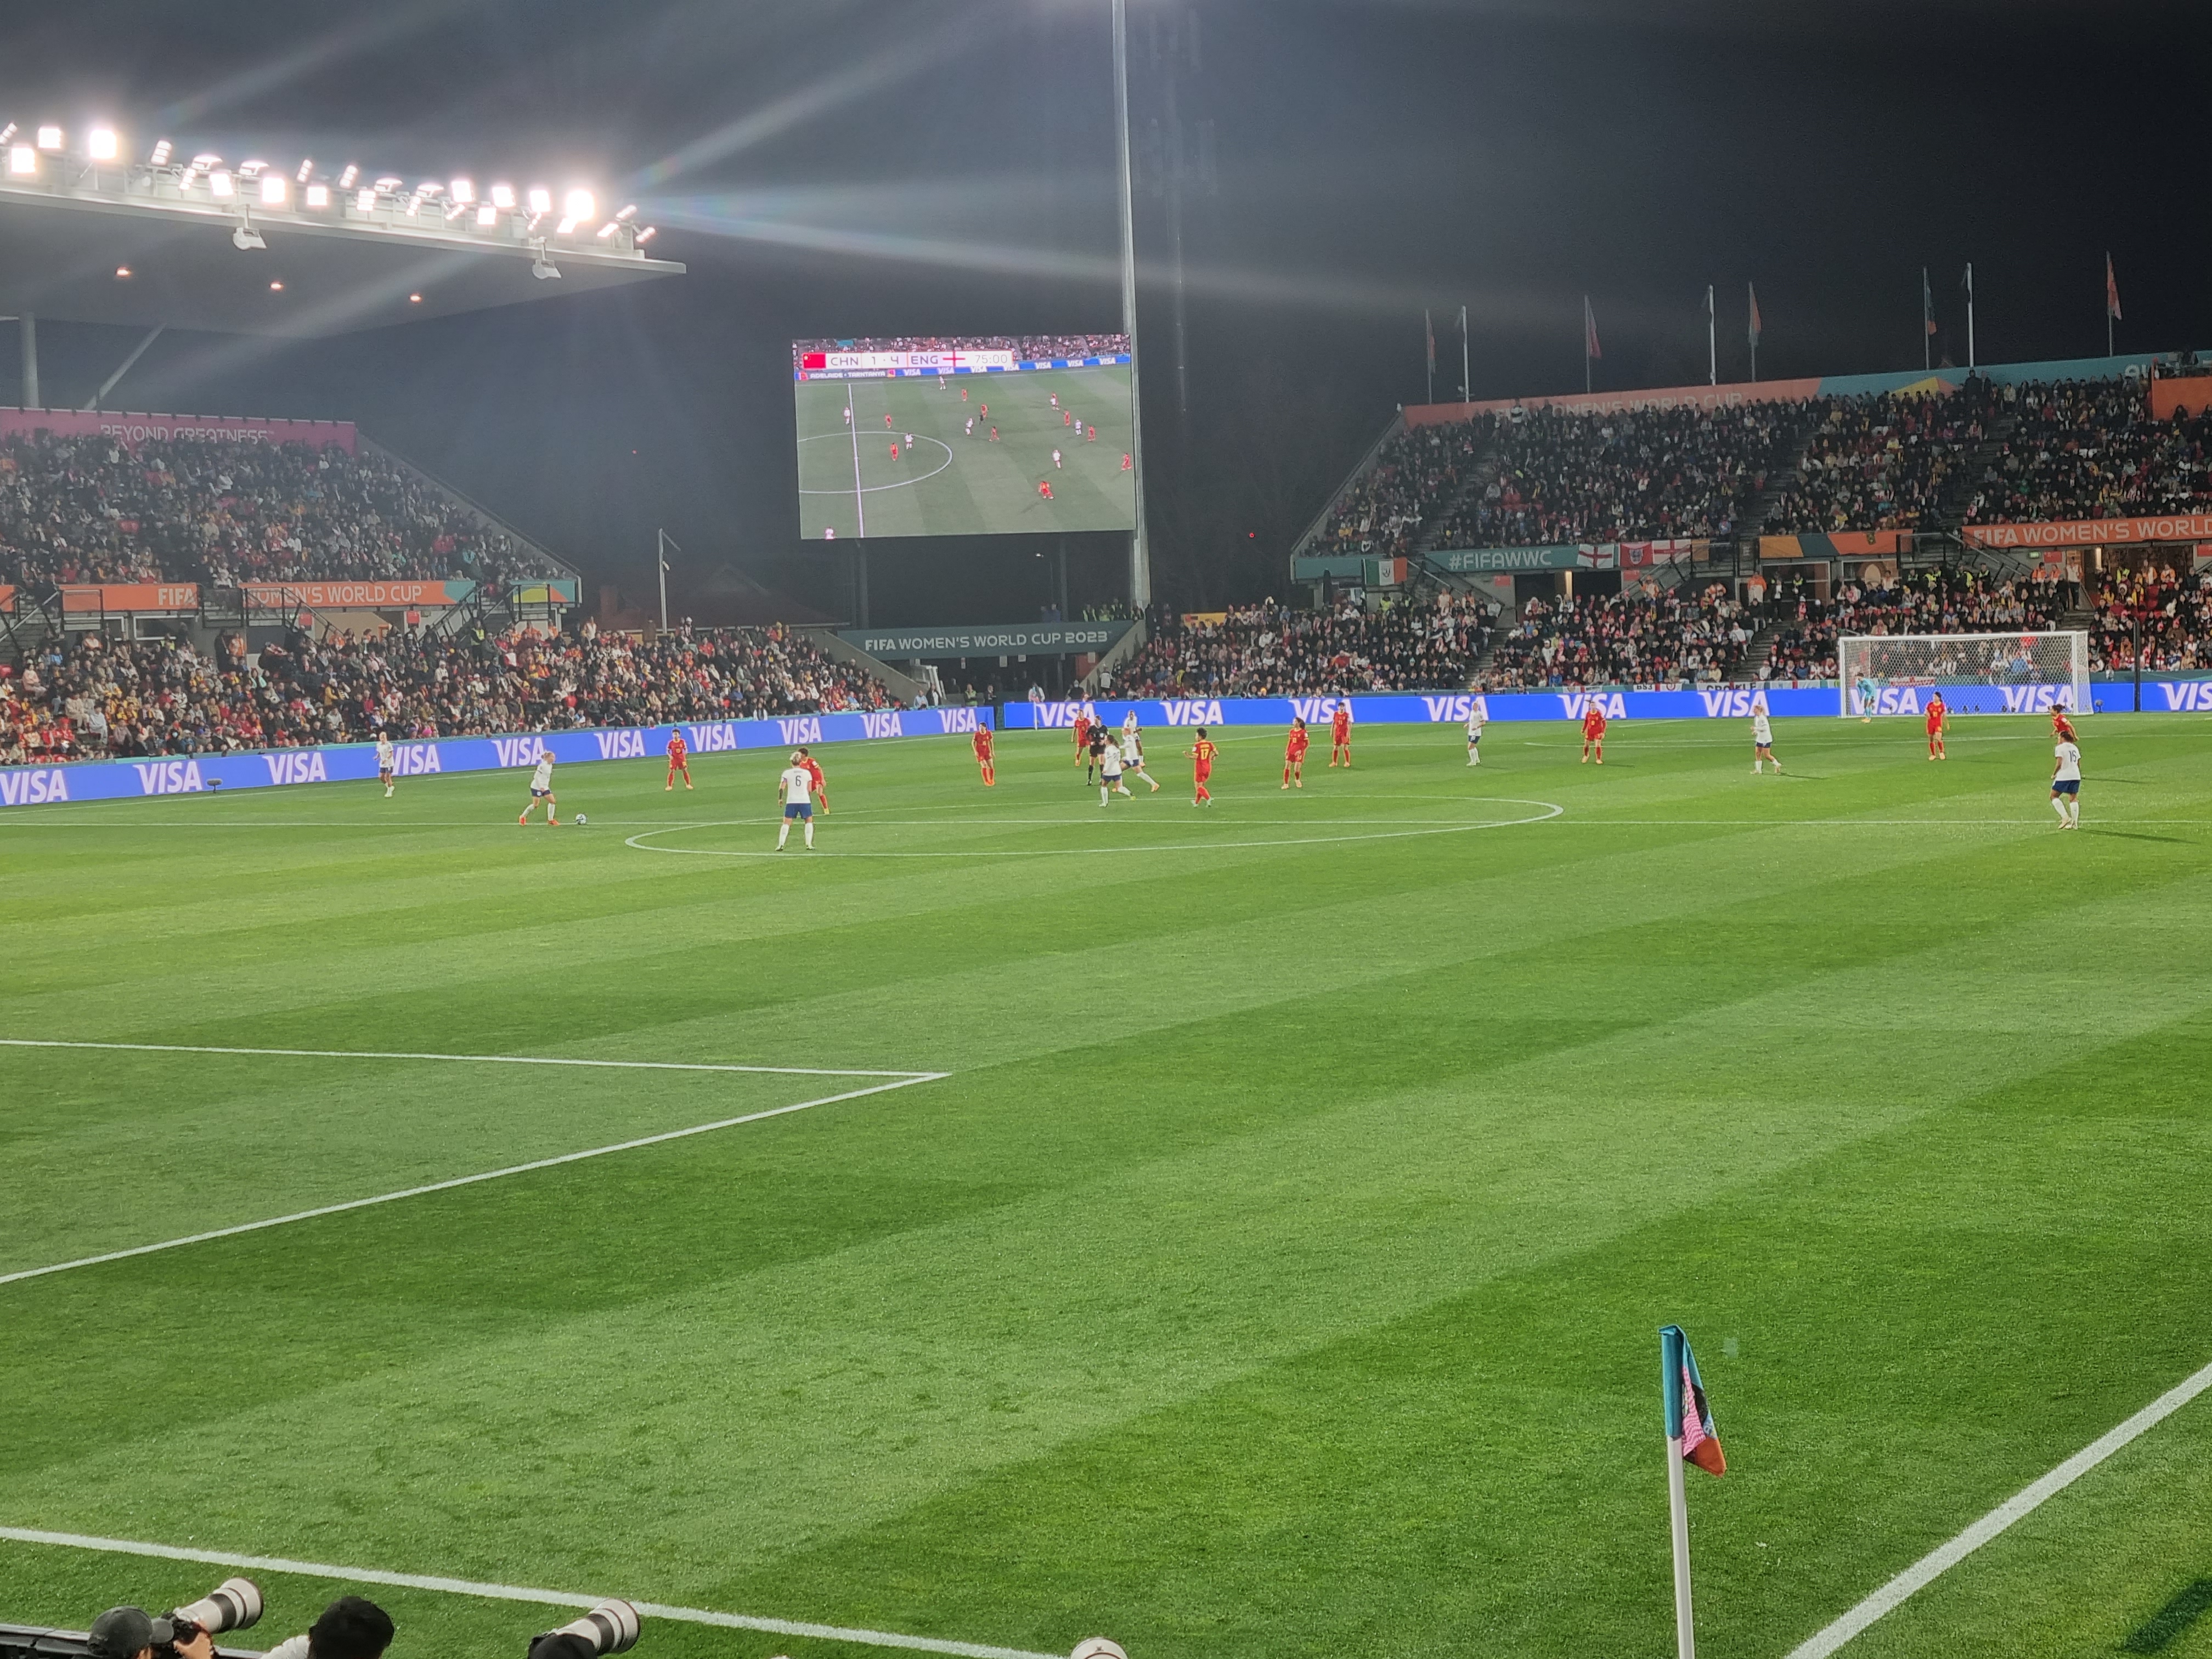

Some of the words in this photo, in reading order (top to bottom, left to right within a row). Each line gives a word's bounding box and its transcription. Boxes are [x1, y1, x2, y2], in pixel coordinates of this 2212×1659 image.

[830, 357, 859, 366] CHN
[871, 356, 876, 365] 1
[890, 355, 899, 364] 4
[911, 355, 939, 365] ENG
[974, 354, 1008, 364] 75:00
[903, 368, 922, 376] VISA
[1035, 361, 1052, 369] VISA
[1098, 357, 1116, 365] VISA
[1553, 400, 1624, 417] OMEN'S
[1703, 392, 1742, 409] CUP
[100, 424, 168, 444] BEYOND
[173, 427, 269, 445] GREATNESS
[1973, 528, 2019, 545] FIFA
[2022, 523, 2130, 543] WOMEN'S
[1448, 550, 1552, 571] #FIFAWWC
[158, 588, 196, 606] FIFA
[327, 585, 386, 603] WORLD
[390, 585, 422, 602] CUP
[865, 639, 896, 651] FIFA
[899, 636, 970, 650] WOMEN'S
[974, 634, 1027, 647] WORLD
[1031, 633, 1061, 645] CUP
[1065, 631, 1108, 644] 2023
[1036, 702, 1096, 727] VISA
[1159, 700, 1224, 726] VISA
[1558, 693, 1627, 719] VISA
[1697, 690, 1770, 716] VISA
[777, 717, 822, 745] VISA
[860, 713, 903, 738] VISA
[938, 708, 978, 733] VISA
[594, 730, 645, 759] VISA
[688, 724, 737, 752] VISA
[491, 737, 545, 767] VISA
[1200, 748, 1210, 760] 17
[2068, 750, 2077, 763] 16
[133, 761, 203, 794] VISA
[262, 752, 326, 785] VISA
[795, 775, 802, 787] 6
[0, 770, 69, 805] VISA
